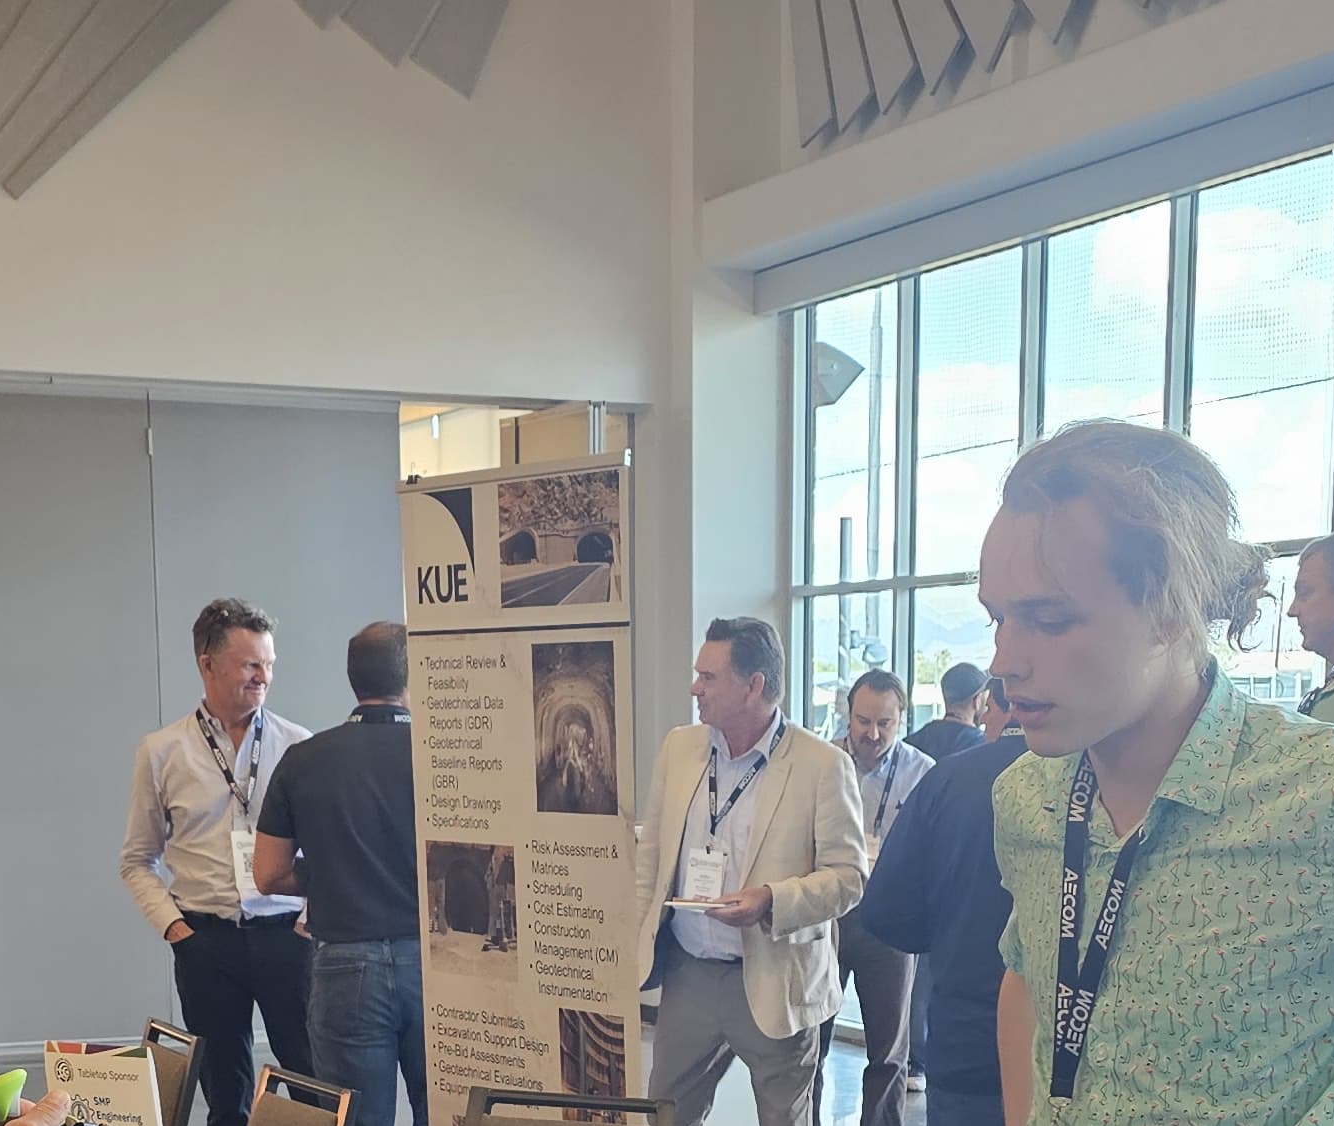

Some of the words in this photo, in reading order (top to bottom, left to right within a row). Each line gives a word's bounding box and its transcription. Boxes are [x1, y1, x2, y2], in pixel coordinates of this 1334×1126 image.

[418, 563, 469, 604] KUE
[424, 655, 464, 670] Technical
[465, 654, 497, 669] Review
[499, 653, 507, 669] &
[427, 676, 469, 693] Feasibility
[426, 695, 482, 710] Geotechnical
[483, 695, 505, 710] Data
[429, 715, 463, 732] Reports
[464, 715, 493, 733] (GDR)
[428, 735, 483, 750] Geotechnical
[431, 754, 467, 769] Baseline
[468, 755, 503, 773] Reports
[432, 774, 459, 790] (GBR)
[1068, 756, 1094, 822] AECOM
[430, 794, 460, 812] Design
[462, 795, 502, 814] Drawings
[431, 813, 490, 831] Specifications
[531, 839, 551, 855] Risk
[553, 841, 609, 859] Assessment
[611, 844, 619, 859] &
[531, 860, 570, 876] Matrices
[532, 880, 583, 902] Scheduling
[533, 900, 555, 916] Cost
[556, 902, 604, 925] Estimating
[1061, 867, 1079, 938] AECOM
[1095, 879, 1125, 951] AECOM
[534, 920, 591, 940] Construction
[534, 940, 594, 960] Management
[595, 946, 619, 968] (CM)
[535, 960, 595, 981] Geotechnical
[538, 980, 608, 1003] Instrumentation
[436, 1004, 480, 1022] Contractor
[481, 1010, 526, 1030] Submittals
[1056, 982, 1074, 1053] AEC
[1064, 989, 1095, 1057] AECOM
[437, 1022, 482, 1041] Excavation
[483, 1030, 517, 1049] Support
[519, 1035, 550, 1056] Design
[438, 1041, 469, 1058] Pre-Bid
[470, 1047, 526, 1069] Assessments
[77, 1068, 108, 1080] Tabletop
[108, 1070, 139, 1082] Sponsor
[438, 1060, 492, 1081] Geotechnical
[494, 1070, 544, 1091] Evaluations
[93, 1096, 111, 1106] SMP
[96, 1110, 143, 1126] Engineering
